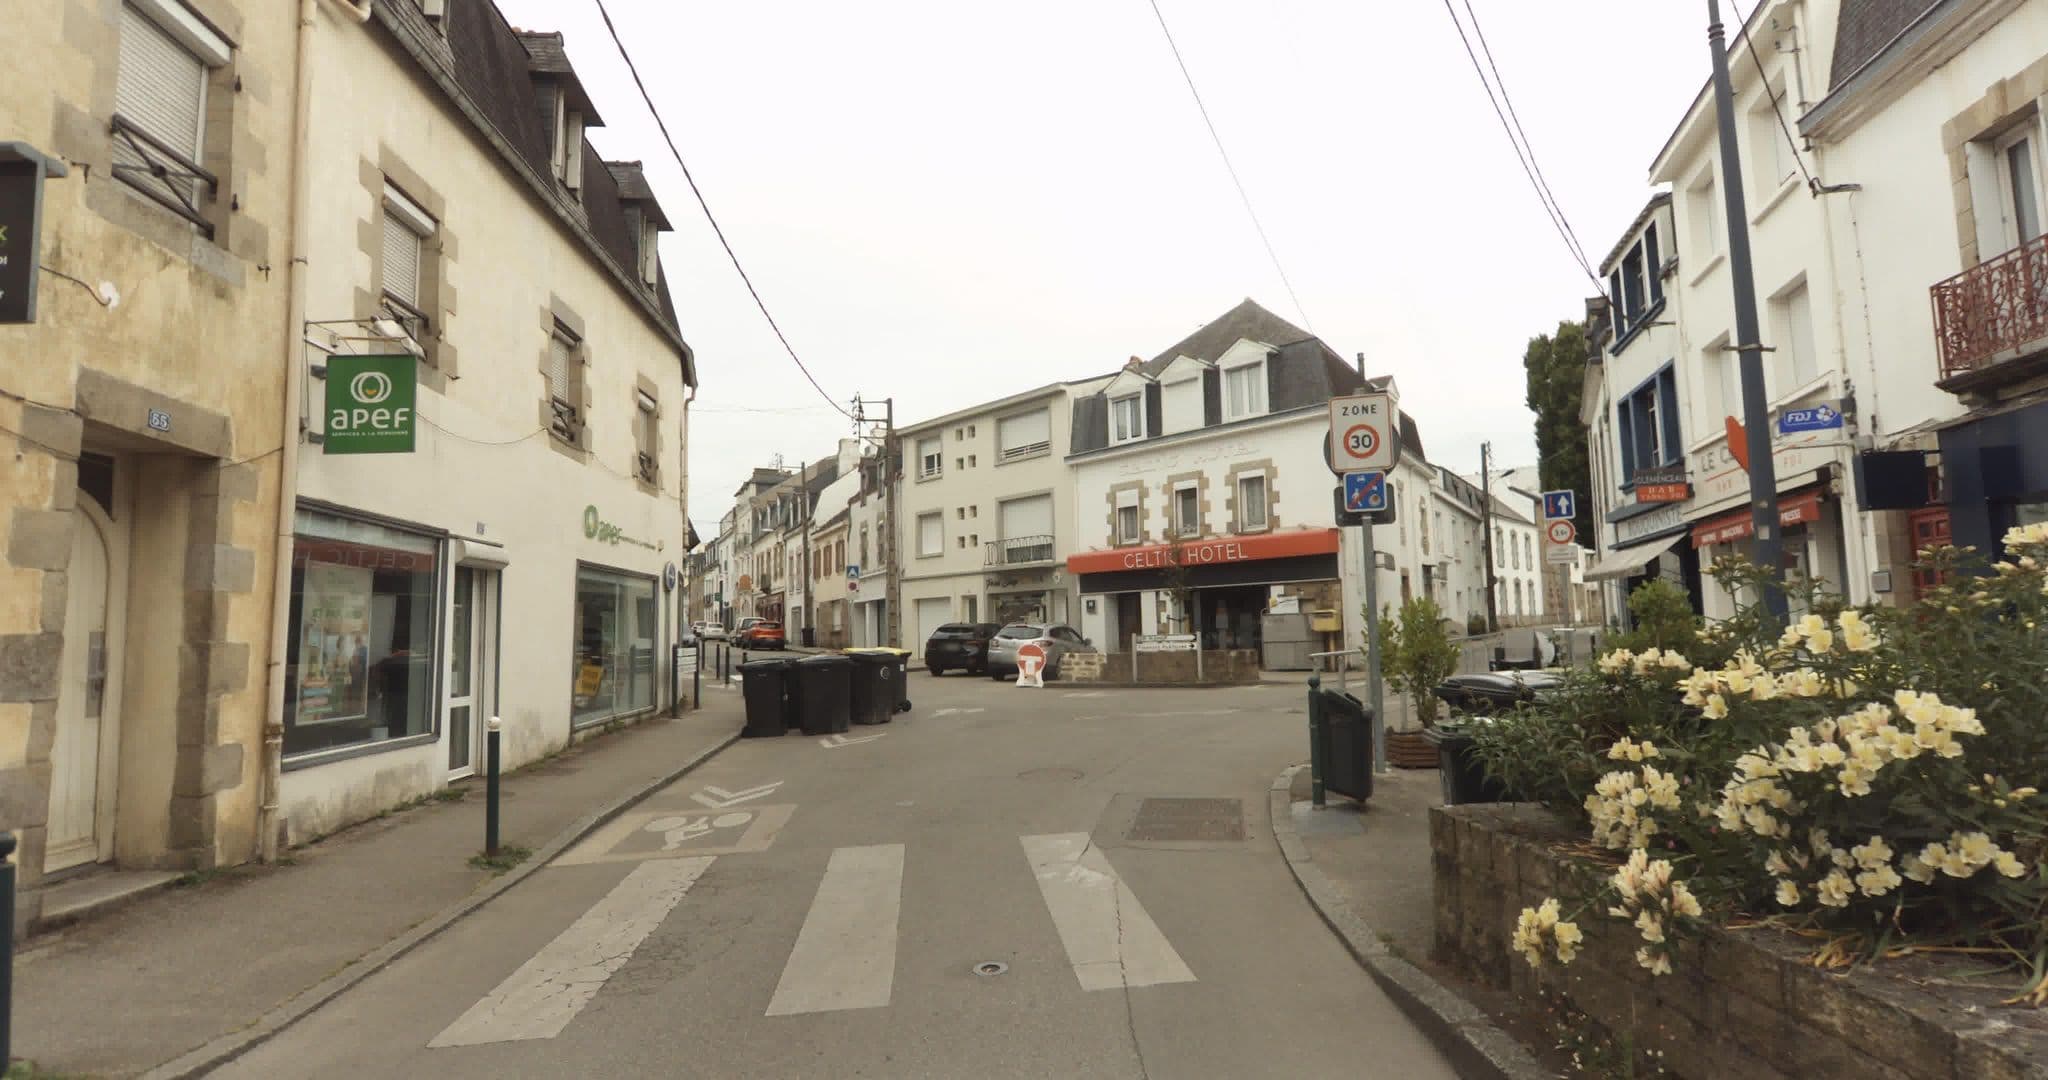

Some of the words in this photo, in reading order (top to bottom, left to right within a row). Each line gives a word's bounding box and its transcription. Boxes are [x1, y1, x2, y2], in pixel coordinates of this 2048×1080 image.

[1342, 404, 1377, 416] ZONE
[1787, 411, 1811, 423] FDJ
[152, 412, 168, 428] 65
[330, 407, 410, 430] apef
[1350, 434, 1373, 449] 30
[1701, 452, 1716, 472] LE
[1187, 543, 1249, 563] HOTEL
